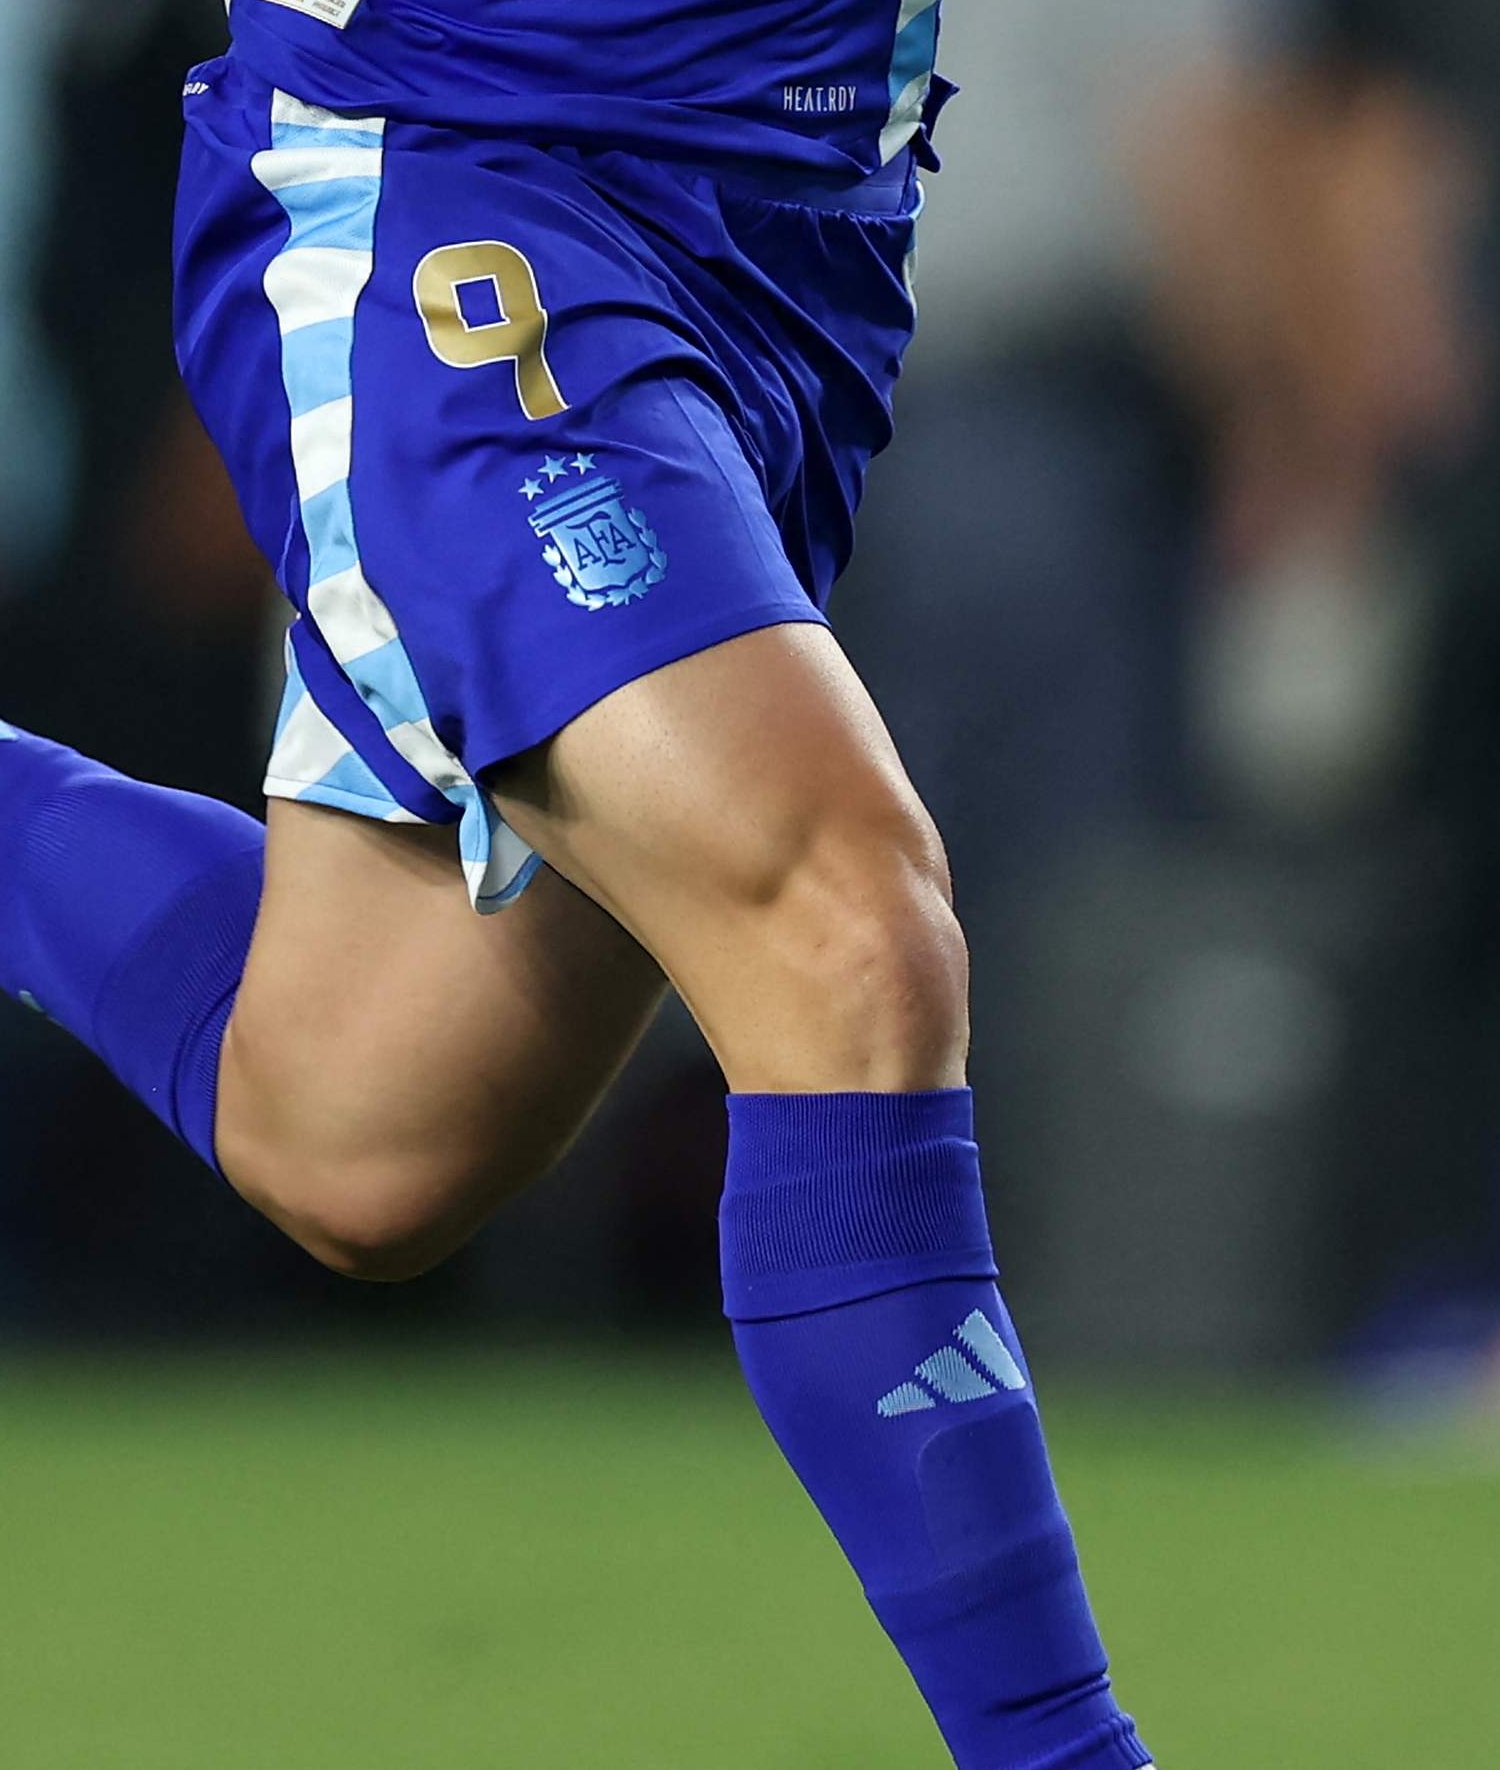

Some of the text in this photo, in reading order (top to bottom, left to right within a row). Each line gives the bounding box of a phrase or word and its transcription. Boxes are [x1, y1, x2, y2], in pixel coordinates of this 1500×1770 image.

[784, 85, 857, 112] HEAT.RDY
[413, 239, 572, 421] 9
[573, 511, 637, 571] AFA
